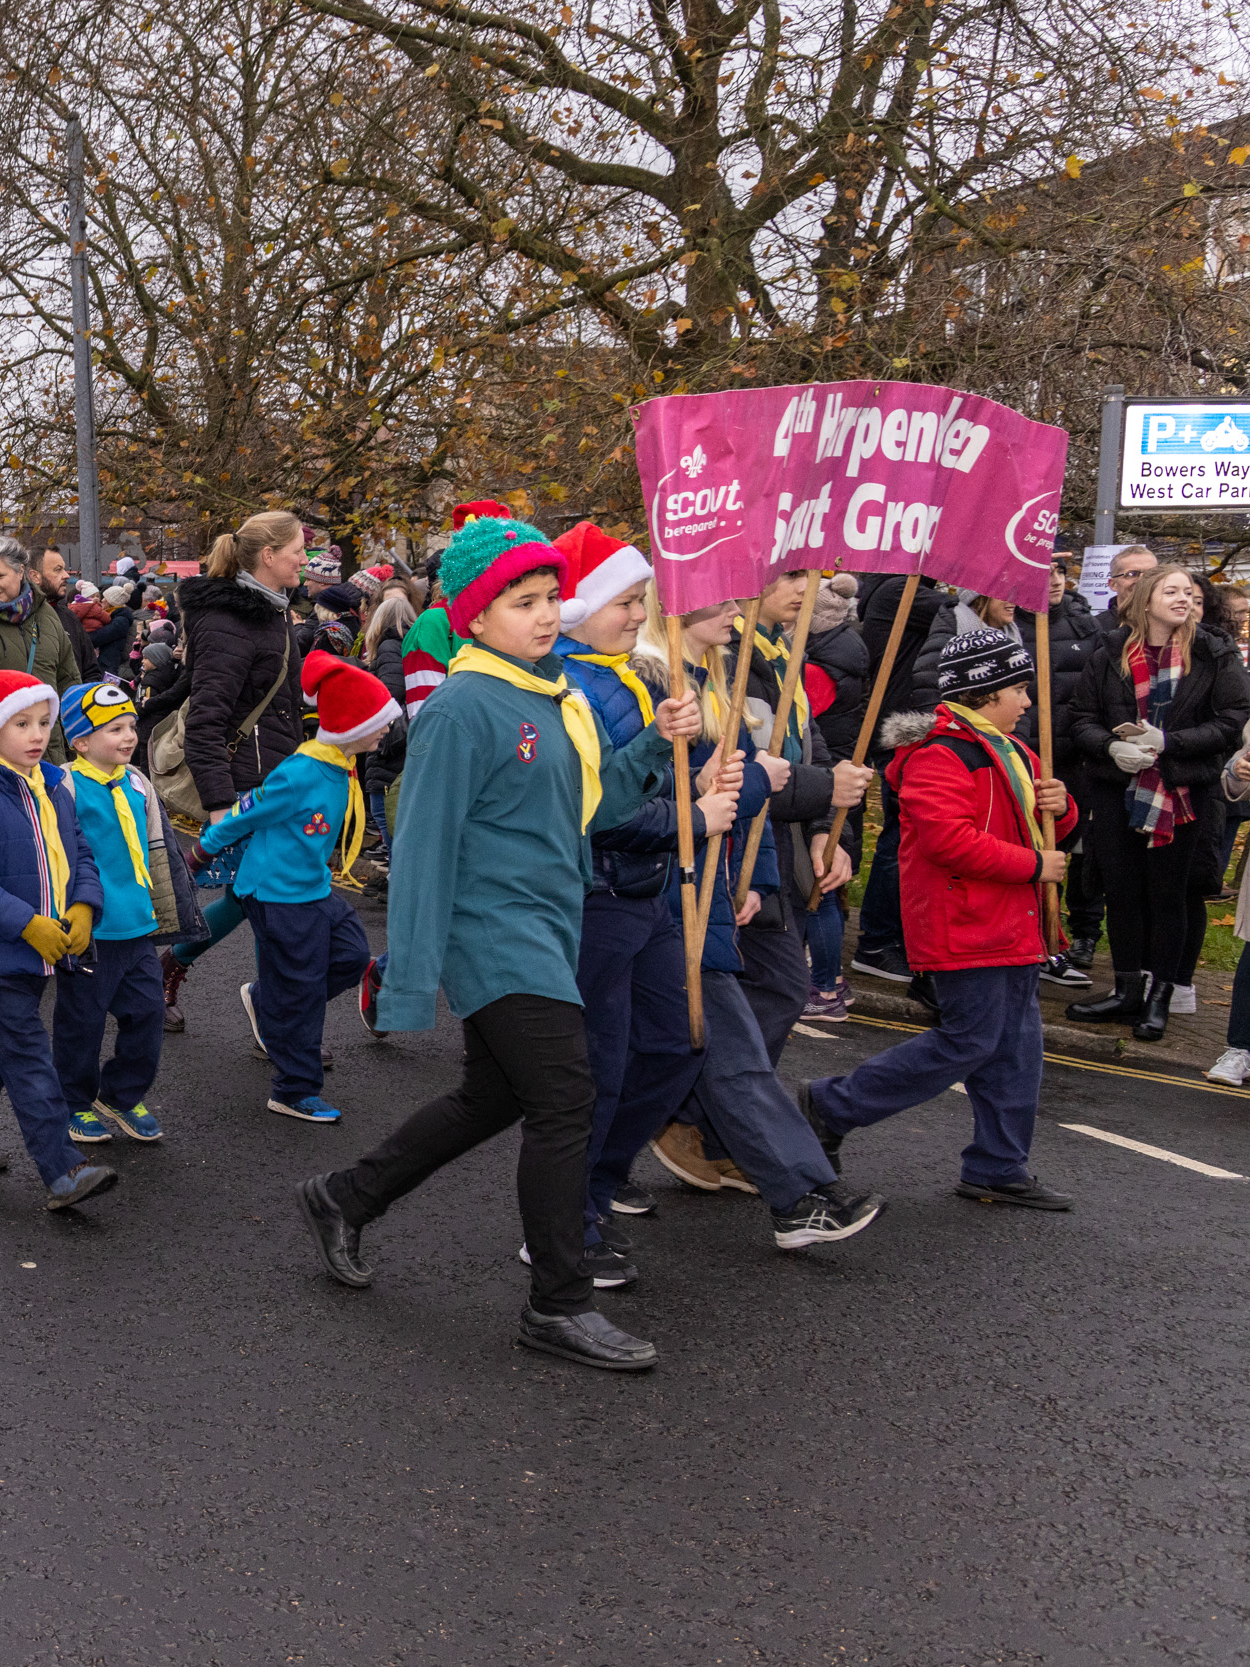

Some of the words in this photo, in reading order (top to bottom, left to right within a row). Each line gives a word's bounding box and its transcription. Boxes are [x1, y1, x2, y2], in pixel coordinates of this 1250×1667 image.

[815, 393, 990, 478] Hrpenden
[1141, 462, 1206, 477] Bowers
[1214, 461, 1250, 480] Way
[1130, 483, 1174, 499] West
[1181, 483, 1212, 499] Car
[1219, 482, 1250, 498] Par
[1023, 532, 1037, 543] be
